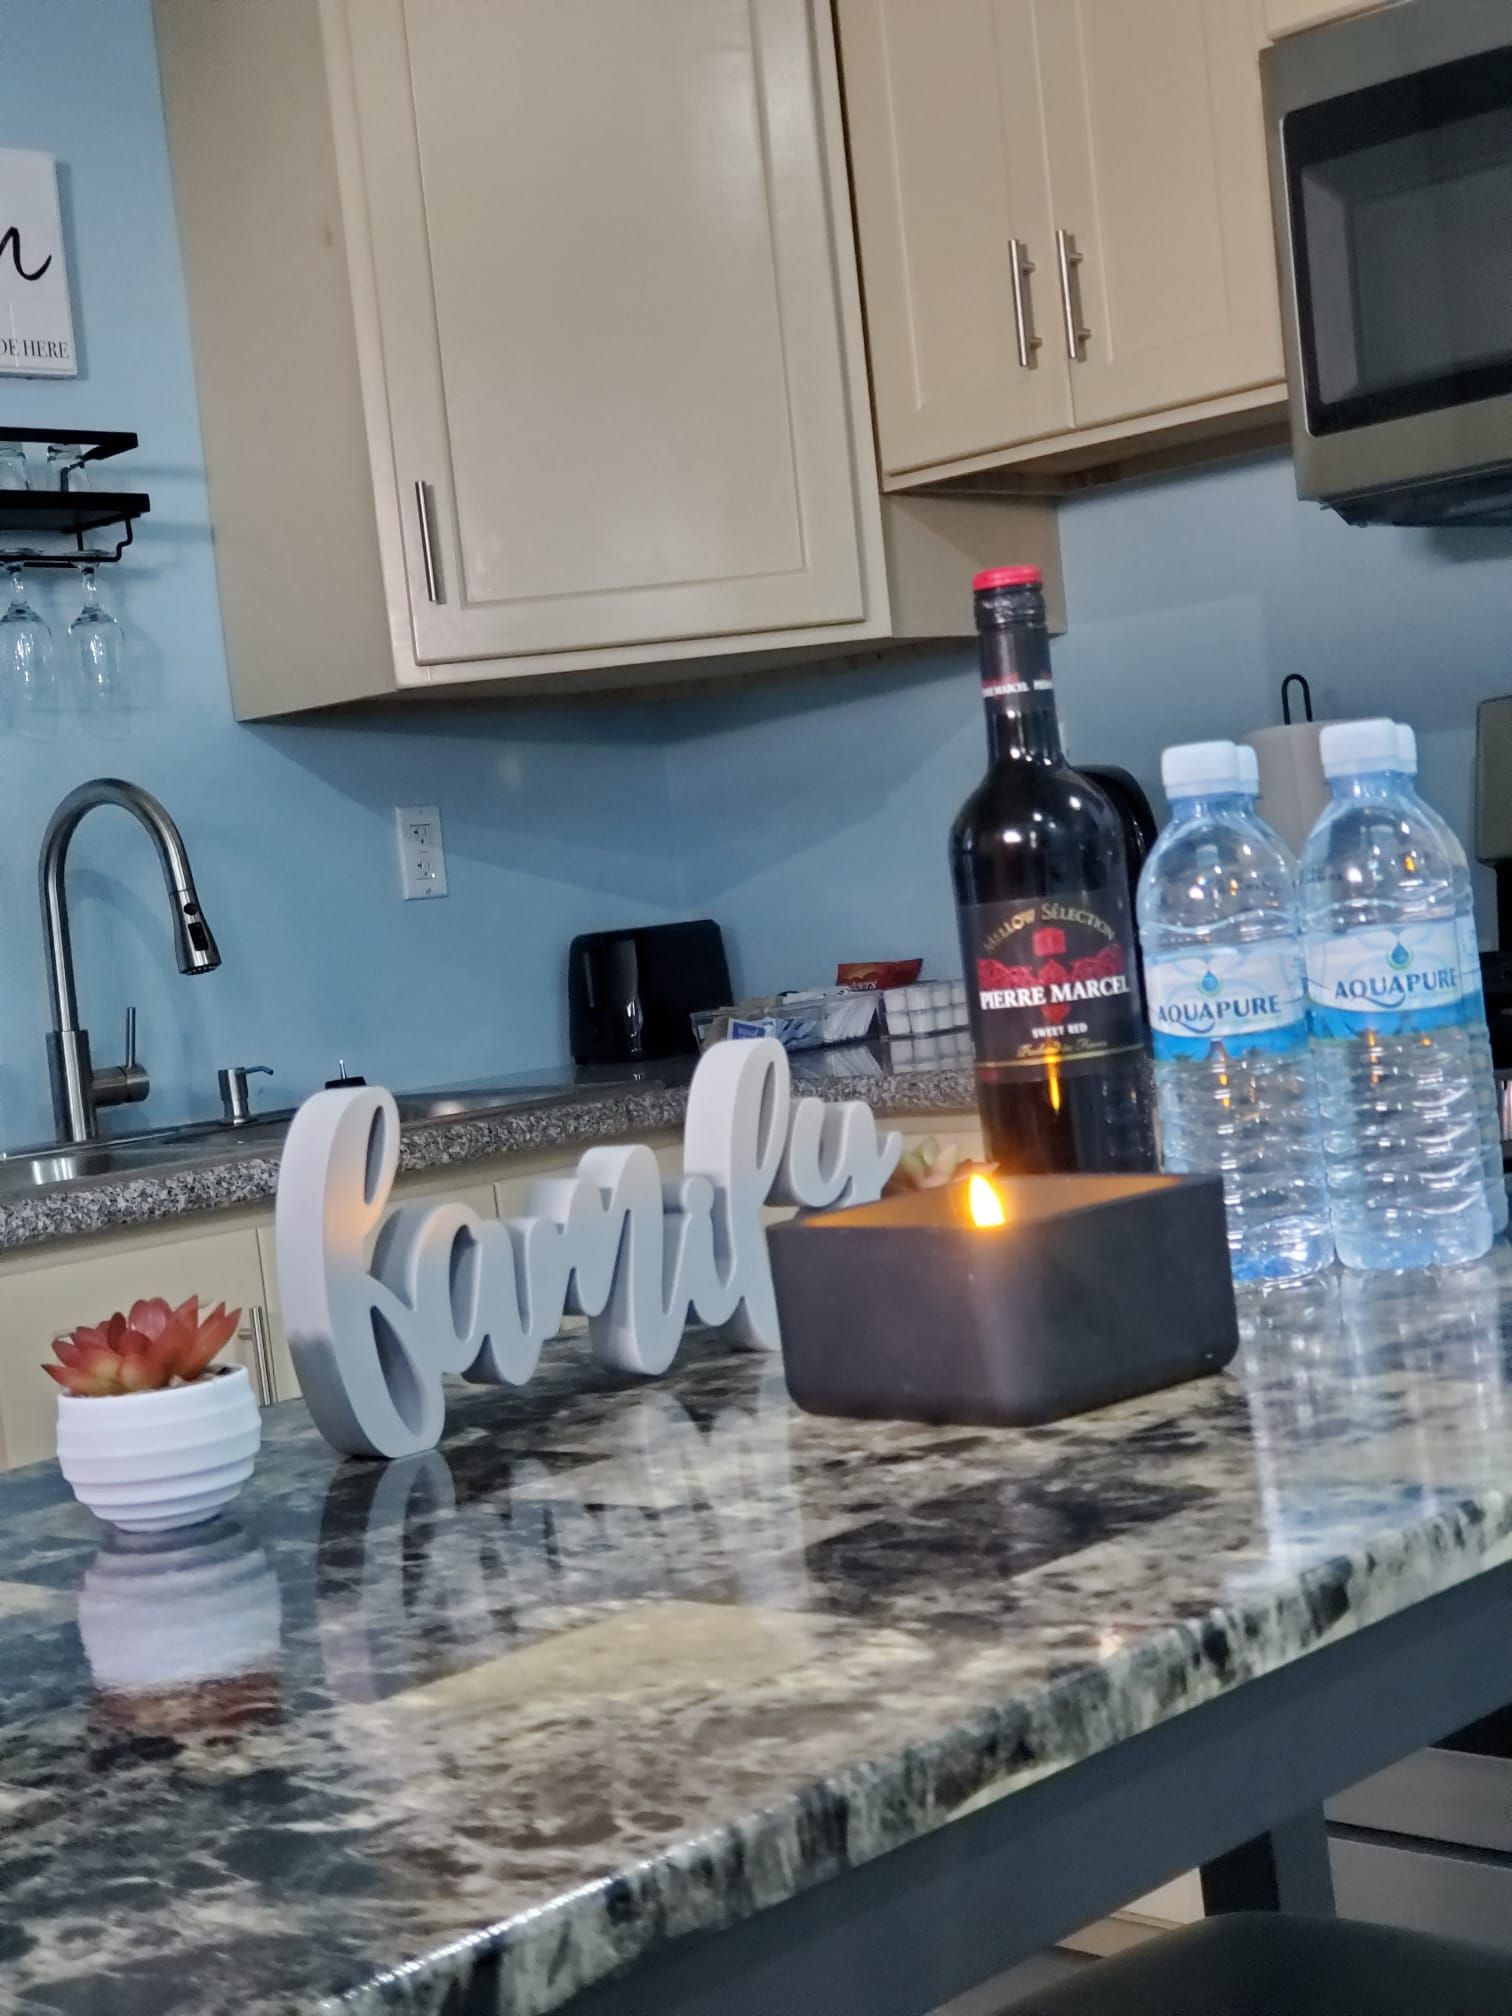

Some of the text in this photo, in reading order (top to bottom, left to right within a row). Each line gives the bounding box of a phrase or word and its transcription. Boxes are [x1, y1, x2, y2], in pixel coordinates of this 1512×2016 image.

[23, 339, 70, 359] HERE
[979, 975, 1130, 1010] PIERRE MARCEL
[1335, 968, 1457, 1008] AQUAPURE
[1032, 1022, 1088, 1039] SWEET RED
[1158, 994, 1281, 1033] AQUAPURE
